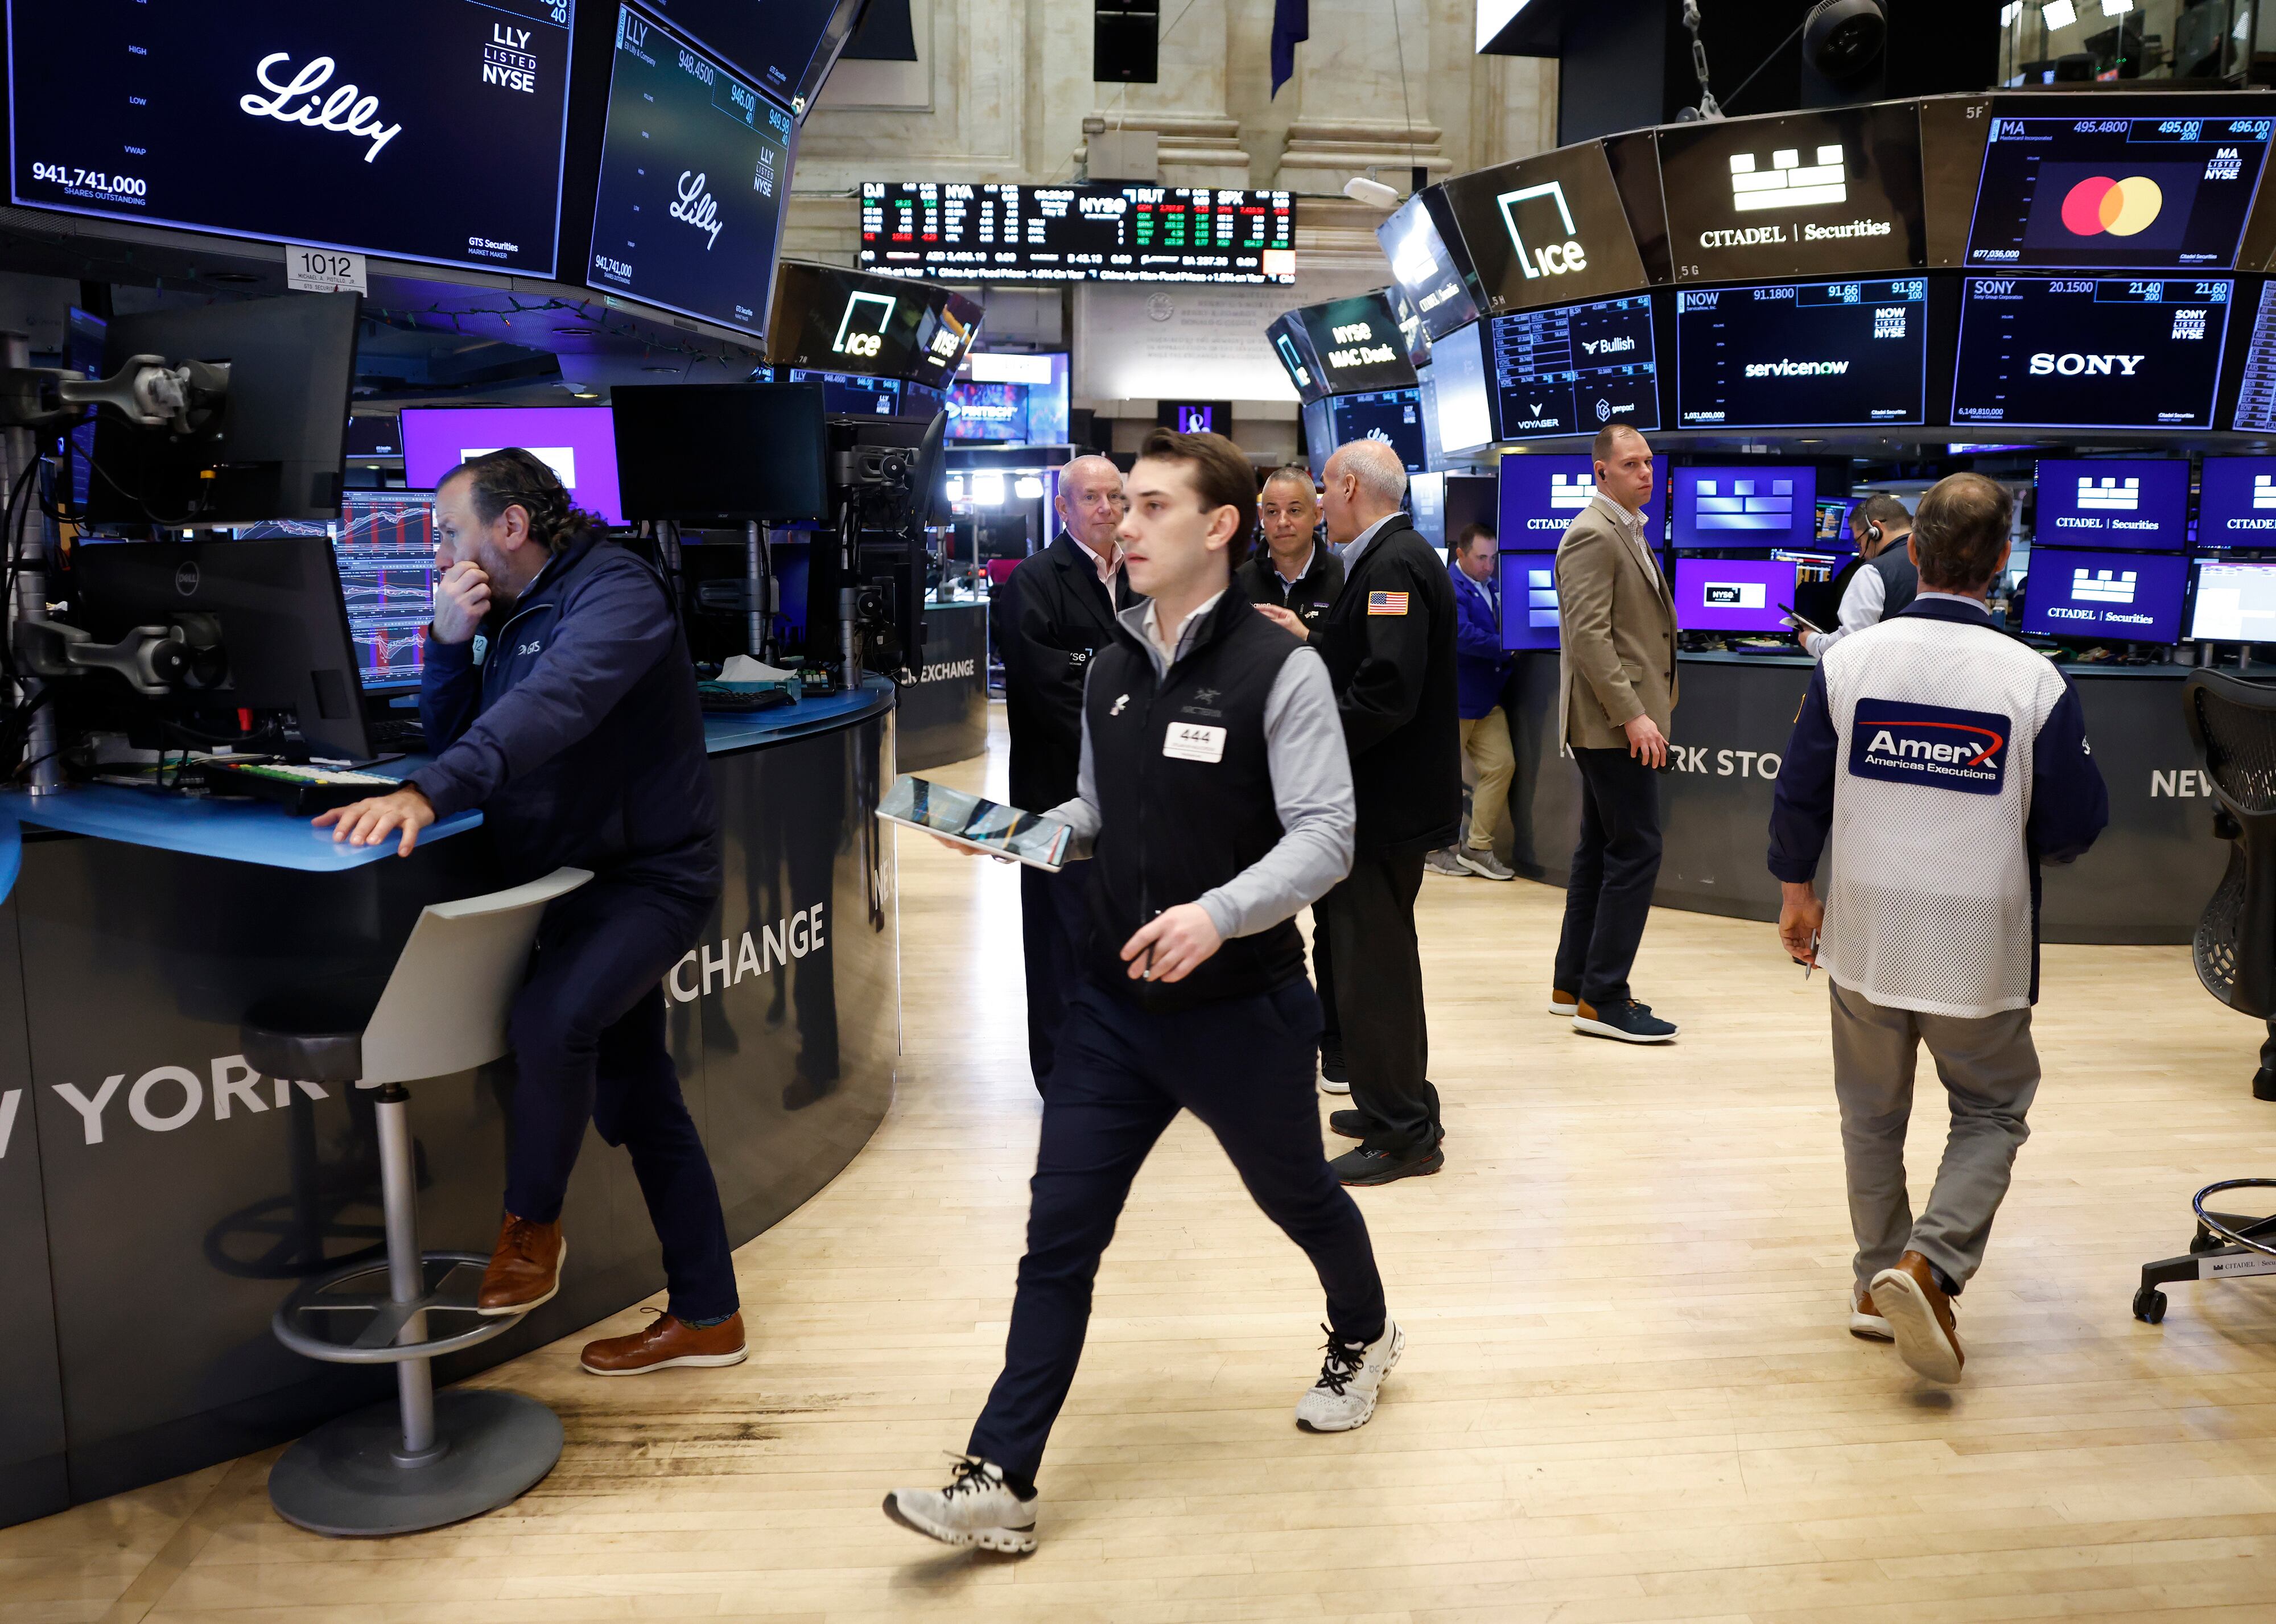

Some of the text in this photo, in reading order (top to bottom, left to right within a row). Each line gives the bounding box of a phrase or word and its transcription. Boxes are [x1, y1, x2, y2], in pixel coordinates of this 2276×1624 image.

[551, 7, 566, 23] 40
[493, 23, 531, 50] LLY
[626, 15, 648, 48] LLY
[129, 45, 147, 55] HIGH
[484, 47, 536, 69] LISTED
[640, 51, 656, 67] Company
[678, 50, 714, 86] 948.4500
[483, 64, 535, 93] NYSE
[130, 96, 146, 106] LOW
[731, 84, 754, 112] 946.00
[240, 52, 403, 163] Lilly
[1966, 106, 1984, 118] 5F
[745, 112, 752, 123] 40
[769, 109, 790, 134] 949.98
[2001, 121, 2270, 135] MA 495.4800 495.00 496.00
[781, 134, 788, 145] 40
[2180, 132, 2197, 141] 200
[124, 145, 146, 155] VWAP
[760, 146, 774, 165] LLY
[2216, 148, 2238, 159] MA
[32, 162, 146, 196] 941,741,000
[756, 164, 774, 180] LISTED
[2204, 170, 2240, 180] NYSE
[753, 176, 773, 197] NYSE
[863, 183, 885, 199] DJI
[945, 184, 974, 200] NYA
[64, 187, 146, 206] SHARES OUTSTANDING
[1138, 188, 1165, 203] RUT
[1218, 191, 1244, 205] SPX
[670, 170, 723, 250] Lilly
[1700, 219, 1891, 248] CITADEL Securities
[468, 237, 519, 252] GTS Securities
[468, 248, 508, 259] MARKET MAKER
[1973, 250, 2020, 259] 877,036,000
[301, 253, 351, 277] 1012
[595, 254, 632, 278] 941,741,000
[1687, 292, 1719, 306] NOW
[1754, 288, 1795, 300] 91.1800
[1828, 285, 1858, 296] 91.66
[1892, 281, 1923, 293] 91.99
[1974, 281, 2227, 294] SONY 20.1500 21.40 21.60
[2144, 292, 2159, 301] 300
[1875, 307, 1906, 318] NOW
[2175, 310, 2207, 319] SONY
[1874, 327, 1906, 338] NYSE
[2171, 329, 2204, 340] NYSE
[1600, 336, 1635, 353] Bullish
[1328, 343, 1397, 368] MAC Desk
[1745, 358, 1849, 378] servicenow
[2029, 353, 2145, 376] SONY
[1611, 403, 1634, 414] genpact
[1518, 419, 1559, 429] VOYAGER
[1527, 518, 1574, 530] CITADE
[2056, 517, 2159, 530] CITADEL Securities
[2048, 607, 2154, 625] CITADEL Securities
[527, 641, 540, 654] GTS
[921, 659, 974, 683] EXCHANGE
[1180, 729, 1210, 743] 444
[1867, 729, 1999, 769] AmerX
[1669, 744, 1782, 780] RK STO
[1865, 755, 1996, 781] Americas Executions
[665, 902, 824, 1008] CHANGE
